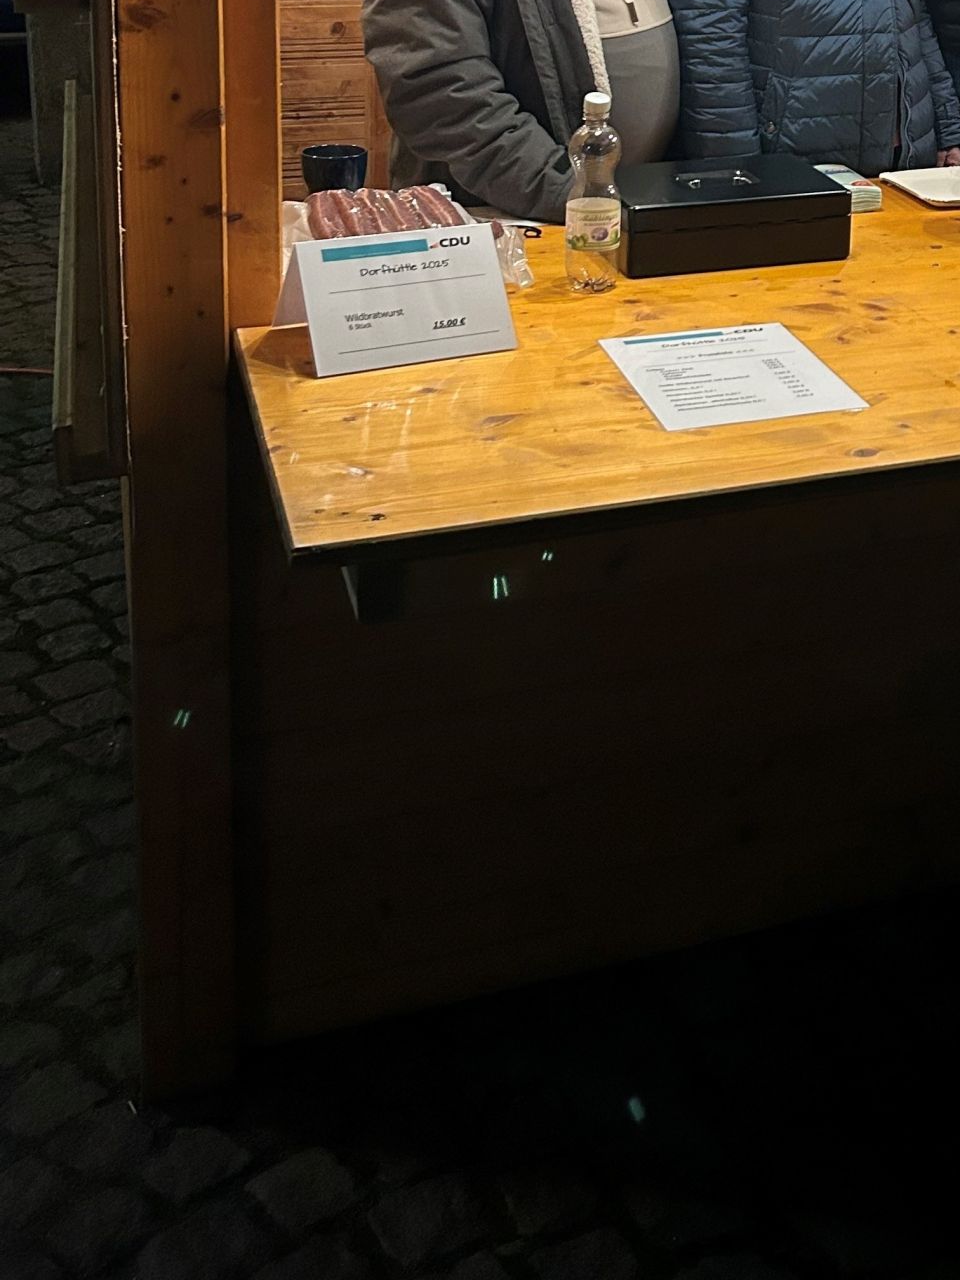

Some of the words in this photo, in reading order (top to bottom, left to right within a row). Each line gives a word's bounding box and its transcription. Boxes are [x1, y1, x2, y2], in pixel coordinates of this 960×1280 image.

[439, 236, 471, 248] CDU
[420, 258, 450, 270] 2025
[344, 308, 404, 323] Wildbratwurst
